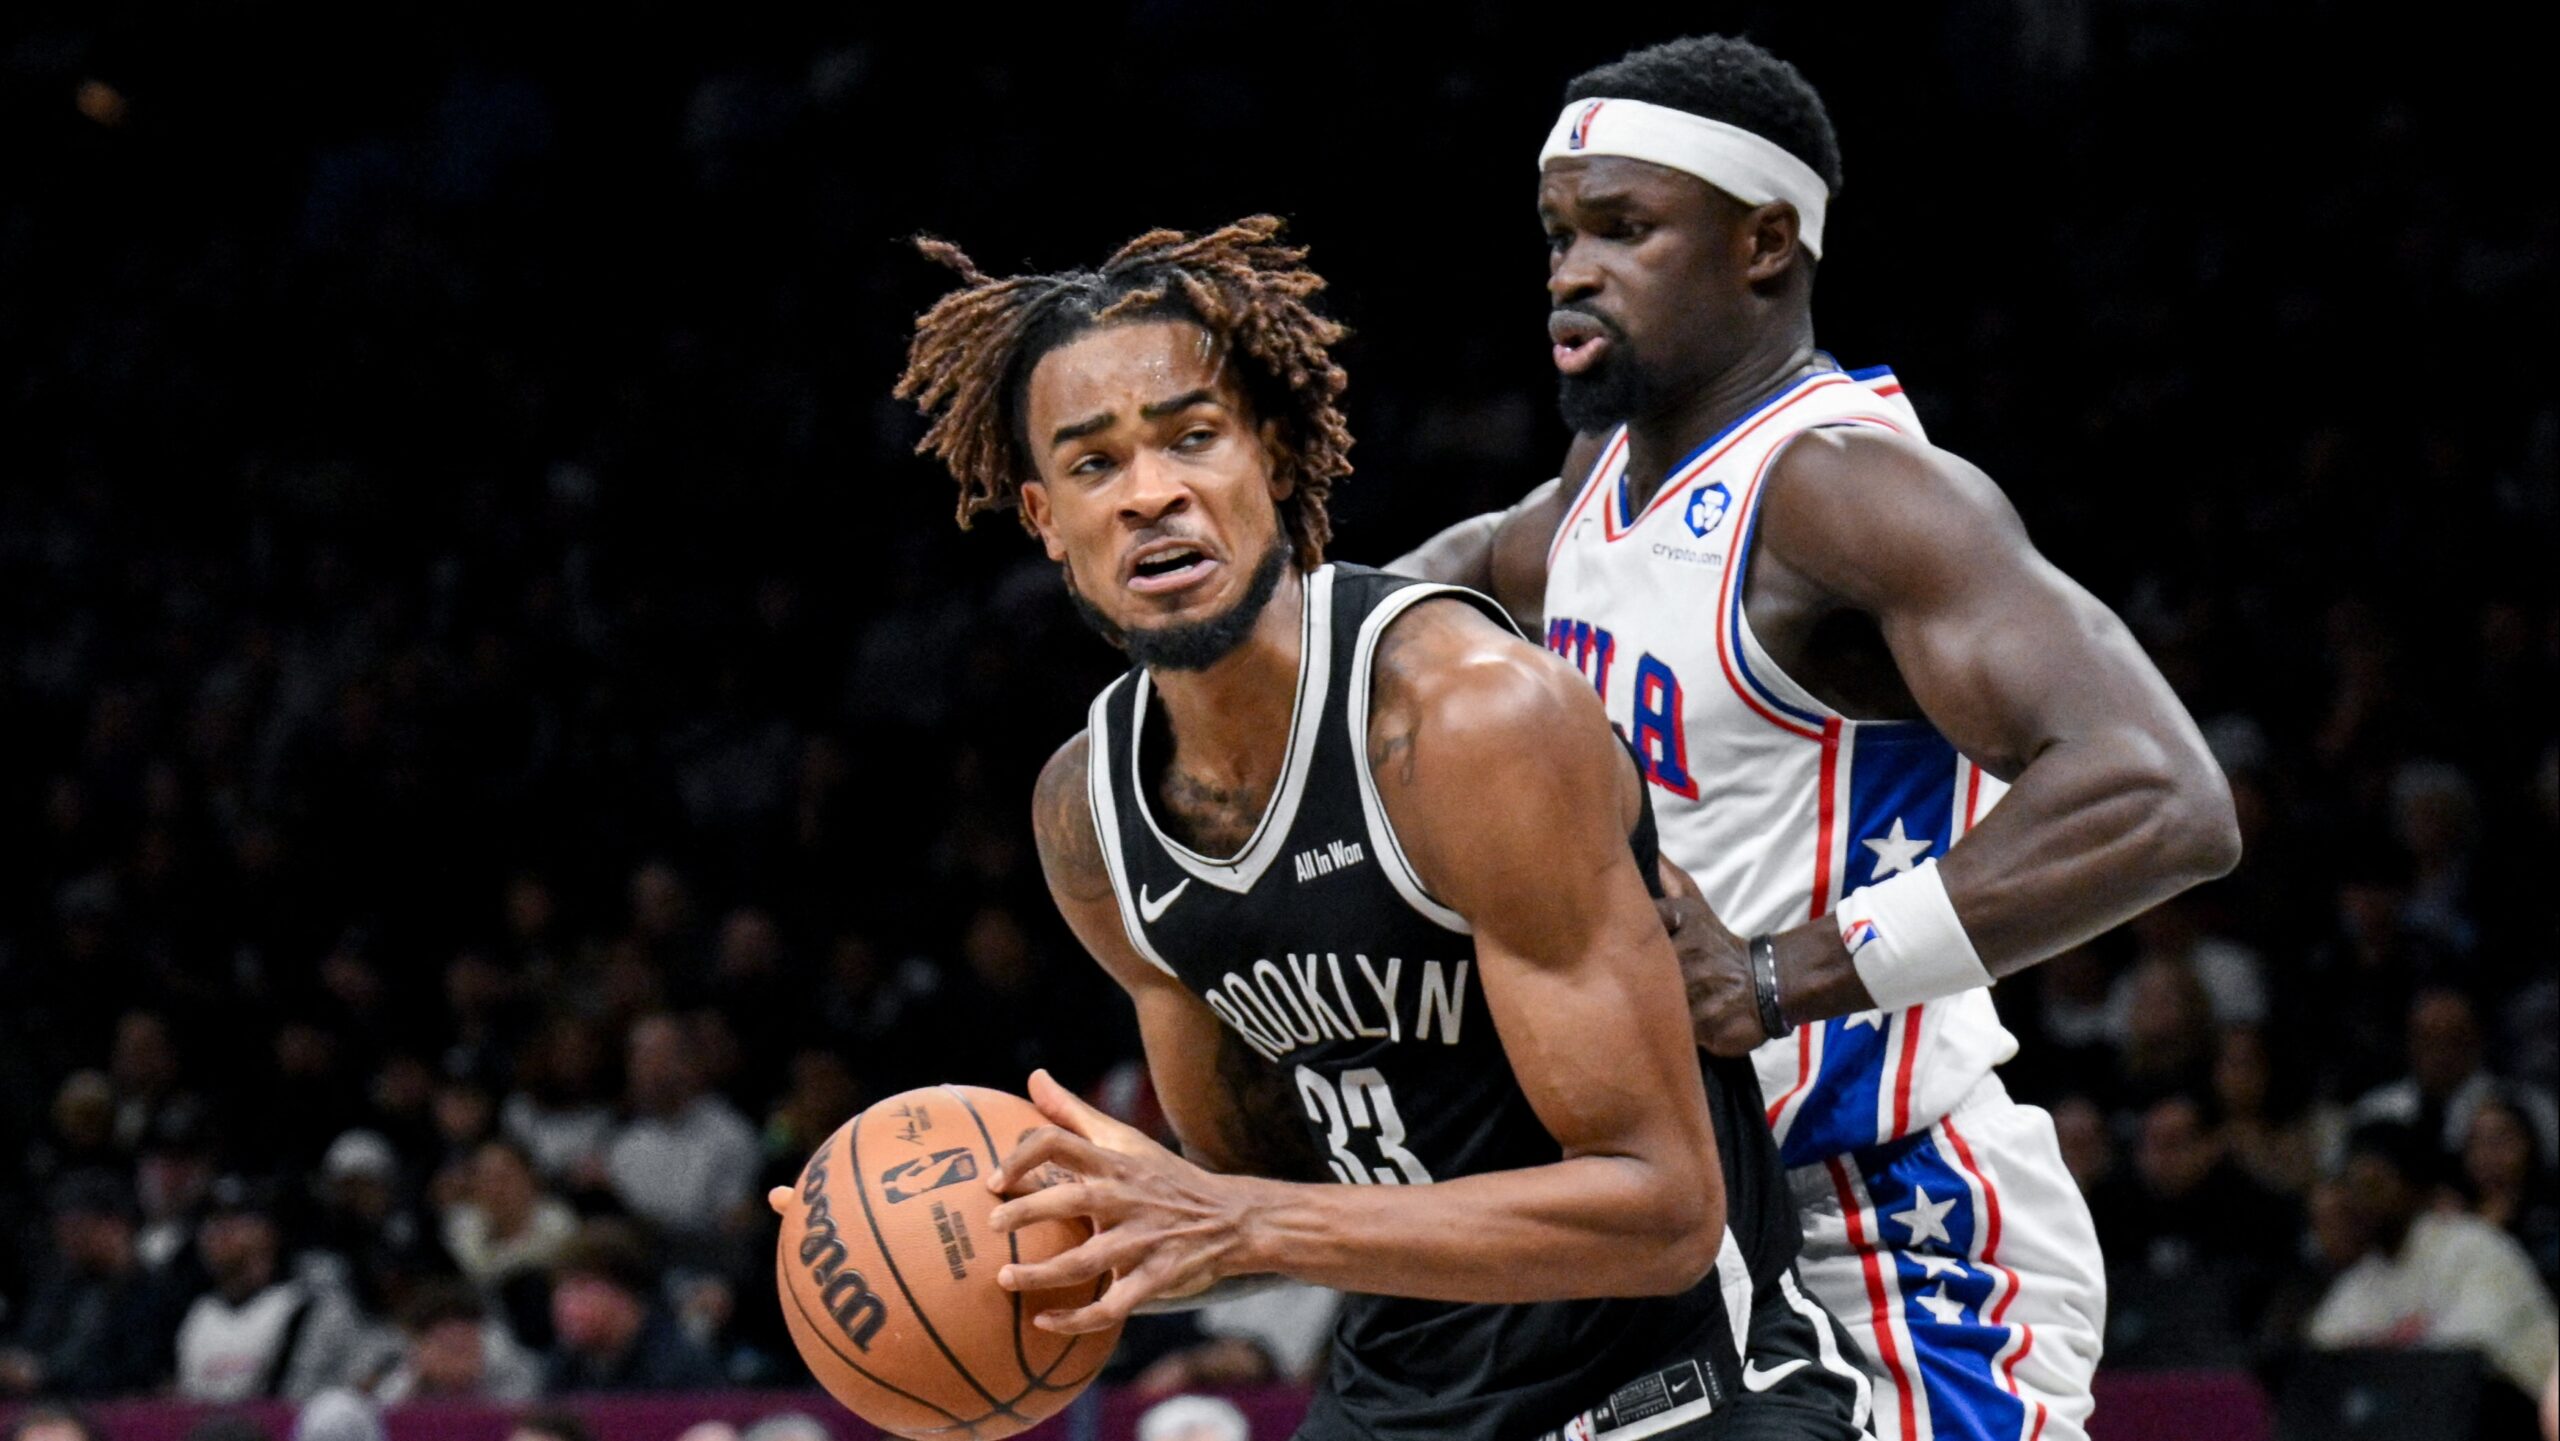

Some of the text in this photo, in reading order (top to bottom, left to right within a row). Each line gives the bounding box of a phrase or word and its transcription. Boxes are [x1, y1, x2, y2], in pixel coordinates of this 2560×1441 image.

[1652, 543, 1722, 566] crypto.om
[1295, 839, 1364, 883] All In Won
[1205, 952, 1469, 1064] ROOKLYN
[1295, 1063, 1434, 1184] 33
